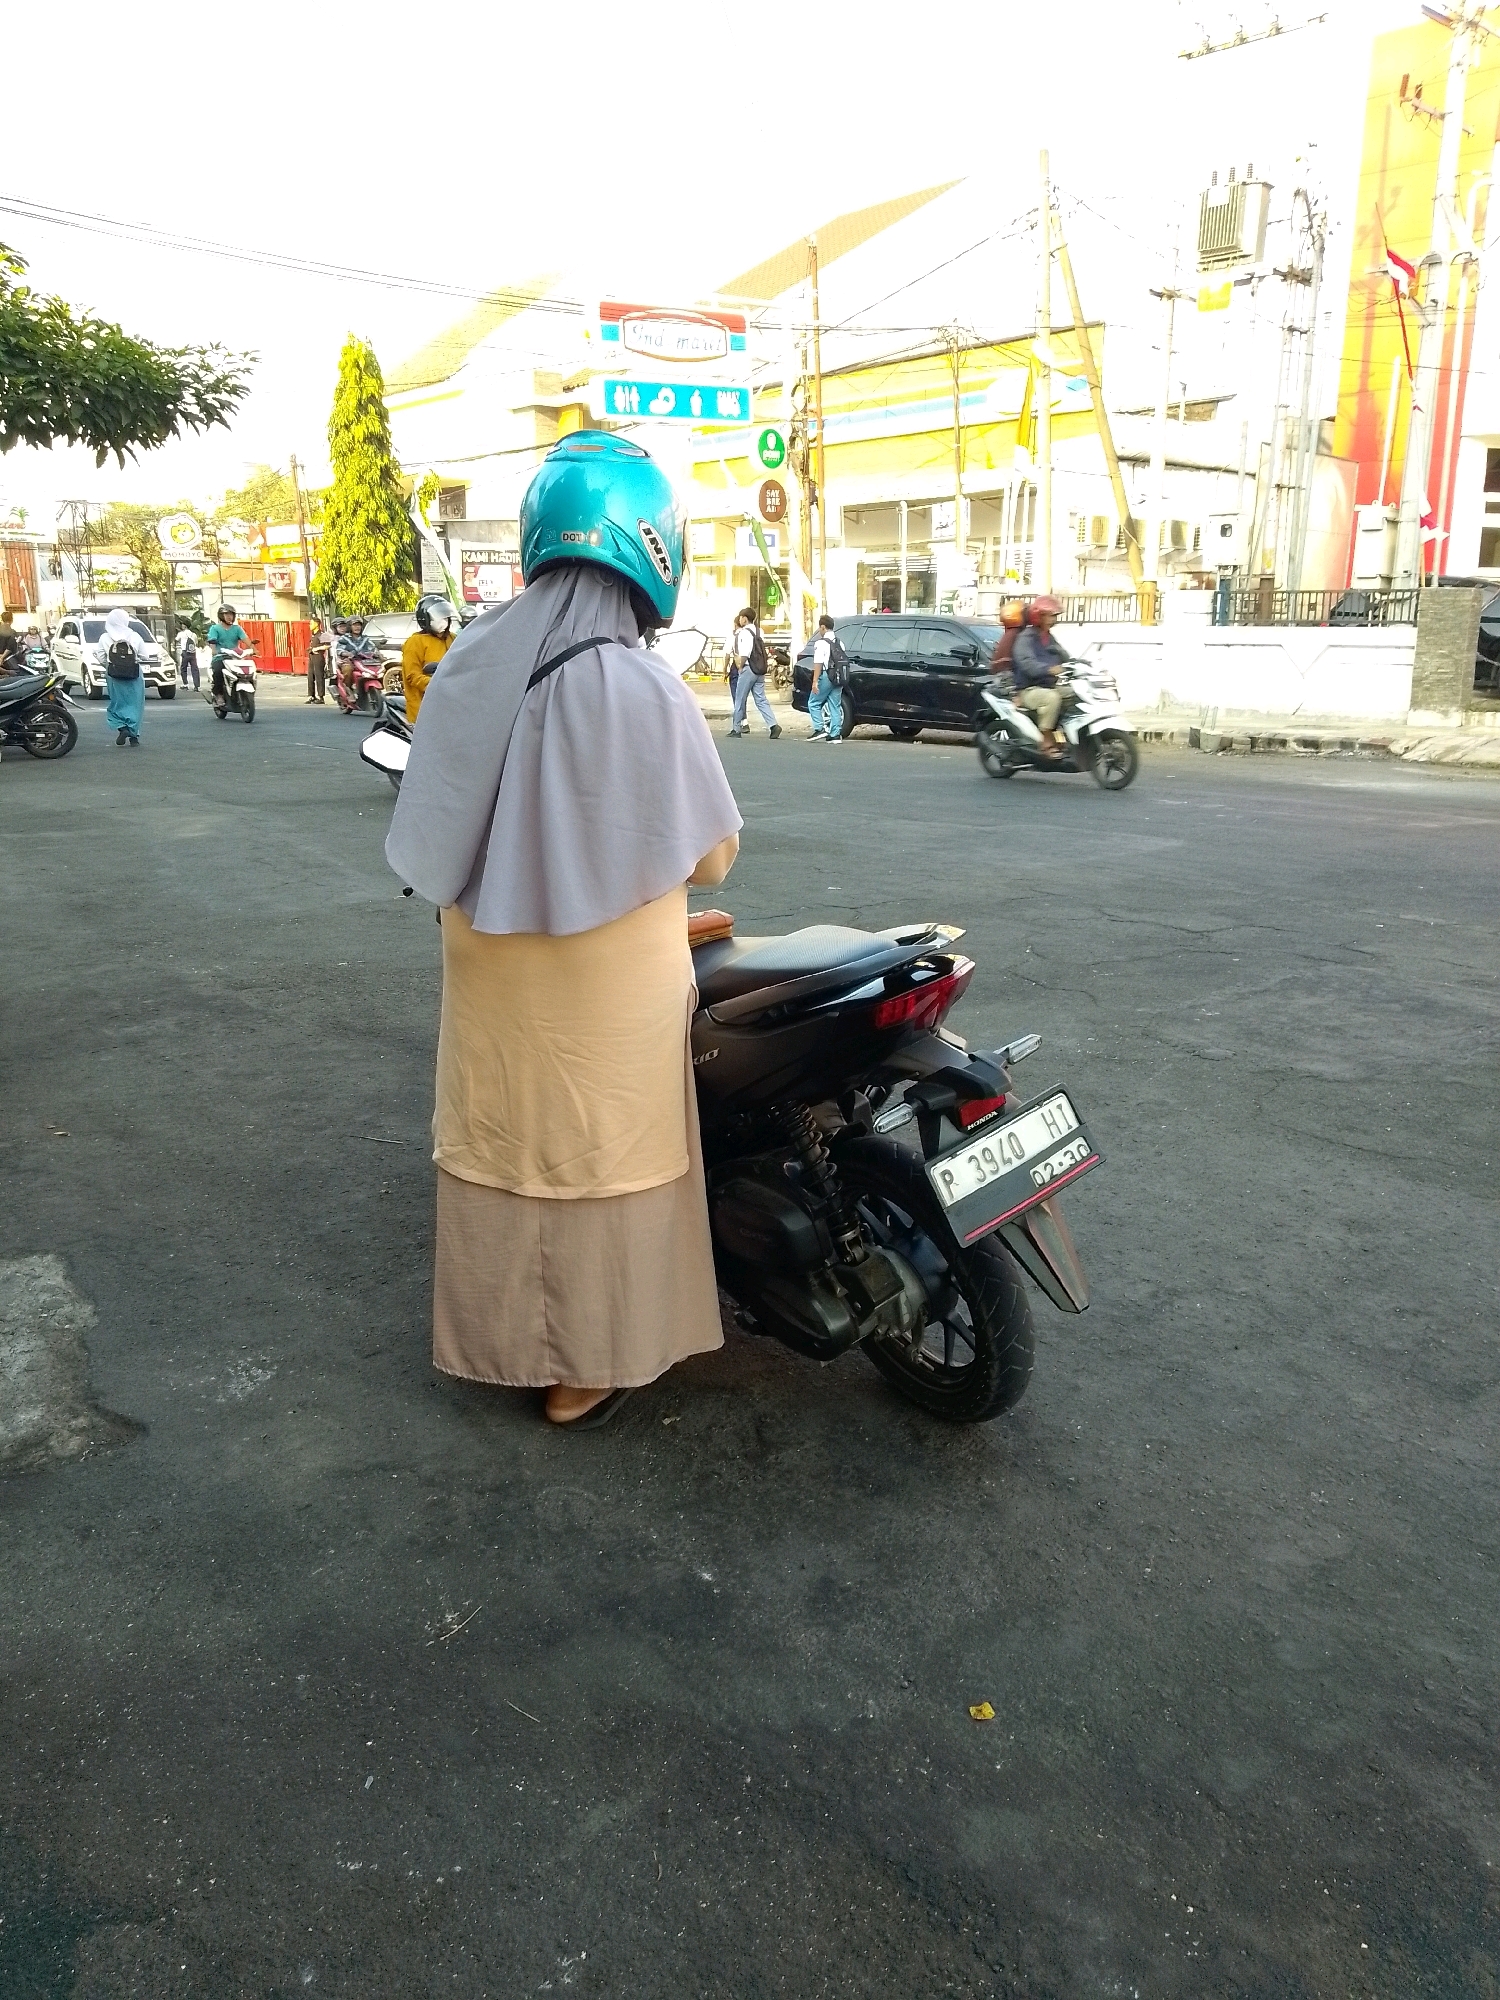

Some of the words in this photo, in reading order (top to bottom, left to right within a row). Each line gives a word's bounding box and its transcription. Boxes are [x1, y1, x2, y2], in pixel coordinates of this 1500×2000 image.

[562, 533, 582, 542] DOT
[462, 551, 488, 563] KAMI
[641, 527, 672, 576] INK
[967, 1110, 998, 1131] HONDA
[939, 1168, 956, 1200] P
[967, 1131, 1026, 1183] 3940
